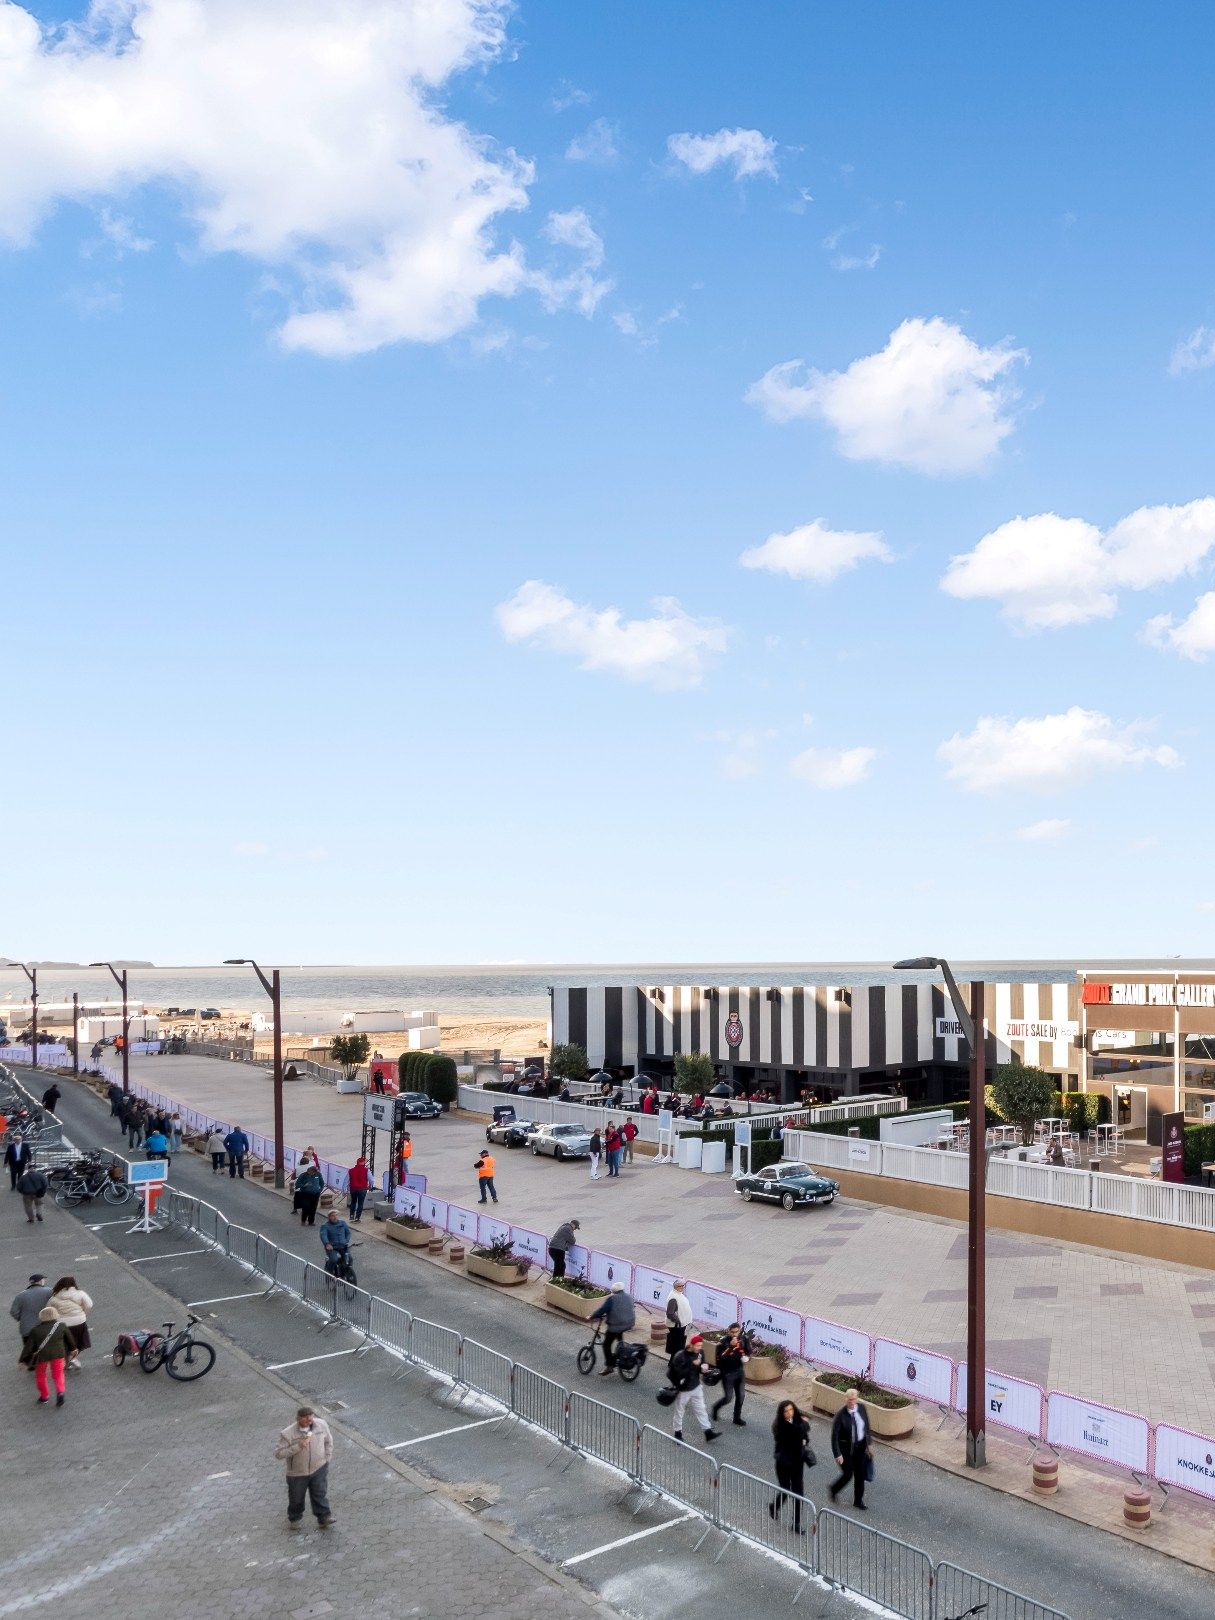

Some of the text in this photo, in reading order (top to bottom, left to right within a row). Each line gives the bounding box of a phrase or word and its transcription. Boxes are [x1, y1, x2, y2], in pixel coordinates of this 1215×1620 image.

[1006, 1023, 1029, 1037] ZOUTE
[1031, 1023, 1048, 1038] SALE
[1049, 1024, 1058, 1040] by
[990, 1399, 1003, 1413] EY
